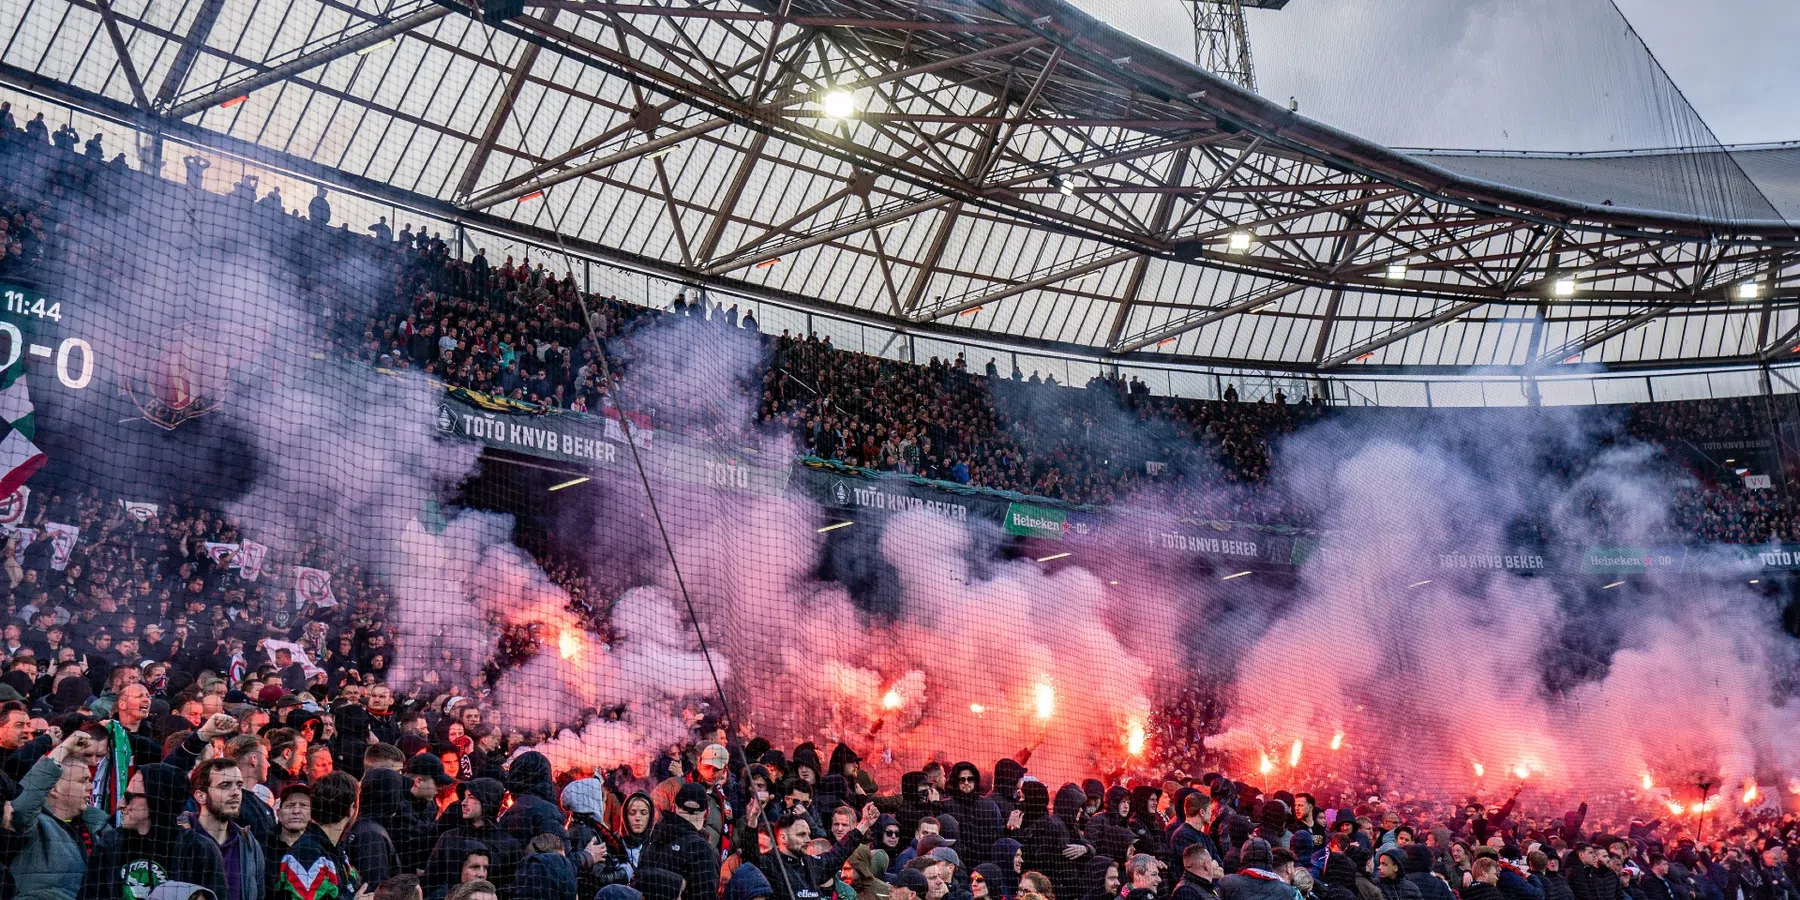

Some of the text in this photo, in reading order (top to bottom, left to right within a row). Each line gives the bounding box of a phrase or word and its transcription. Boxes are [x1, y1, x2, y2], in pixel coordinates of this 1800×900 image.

[5, 290, 62, 322] 11:44
[510, 423, 558, 452] KNVB
[562, 435, 616, 463] BEKER
[1722, 441, 1745, 450] KNVB
[888, 493, 924, 513] KNVB
[926, 500, 967, 522] BEKER
[1013, 513, 1060, 531] Heineken
[1188, 536, 1220, 553] KNVB
[1221, 540, 1258, 557] BEKER
[1469, 555, 1503, 569] KNVB
[1505, 555, 1544, 569] BEKER
[1590, 555, 1641, 566] Heineken
